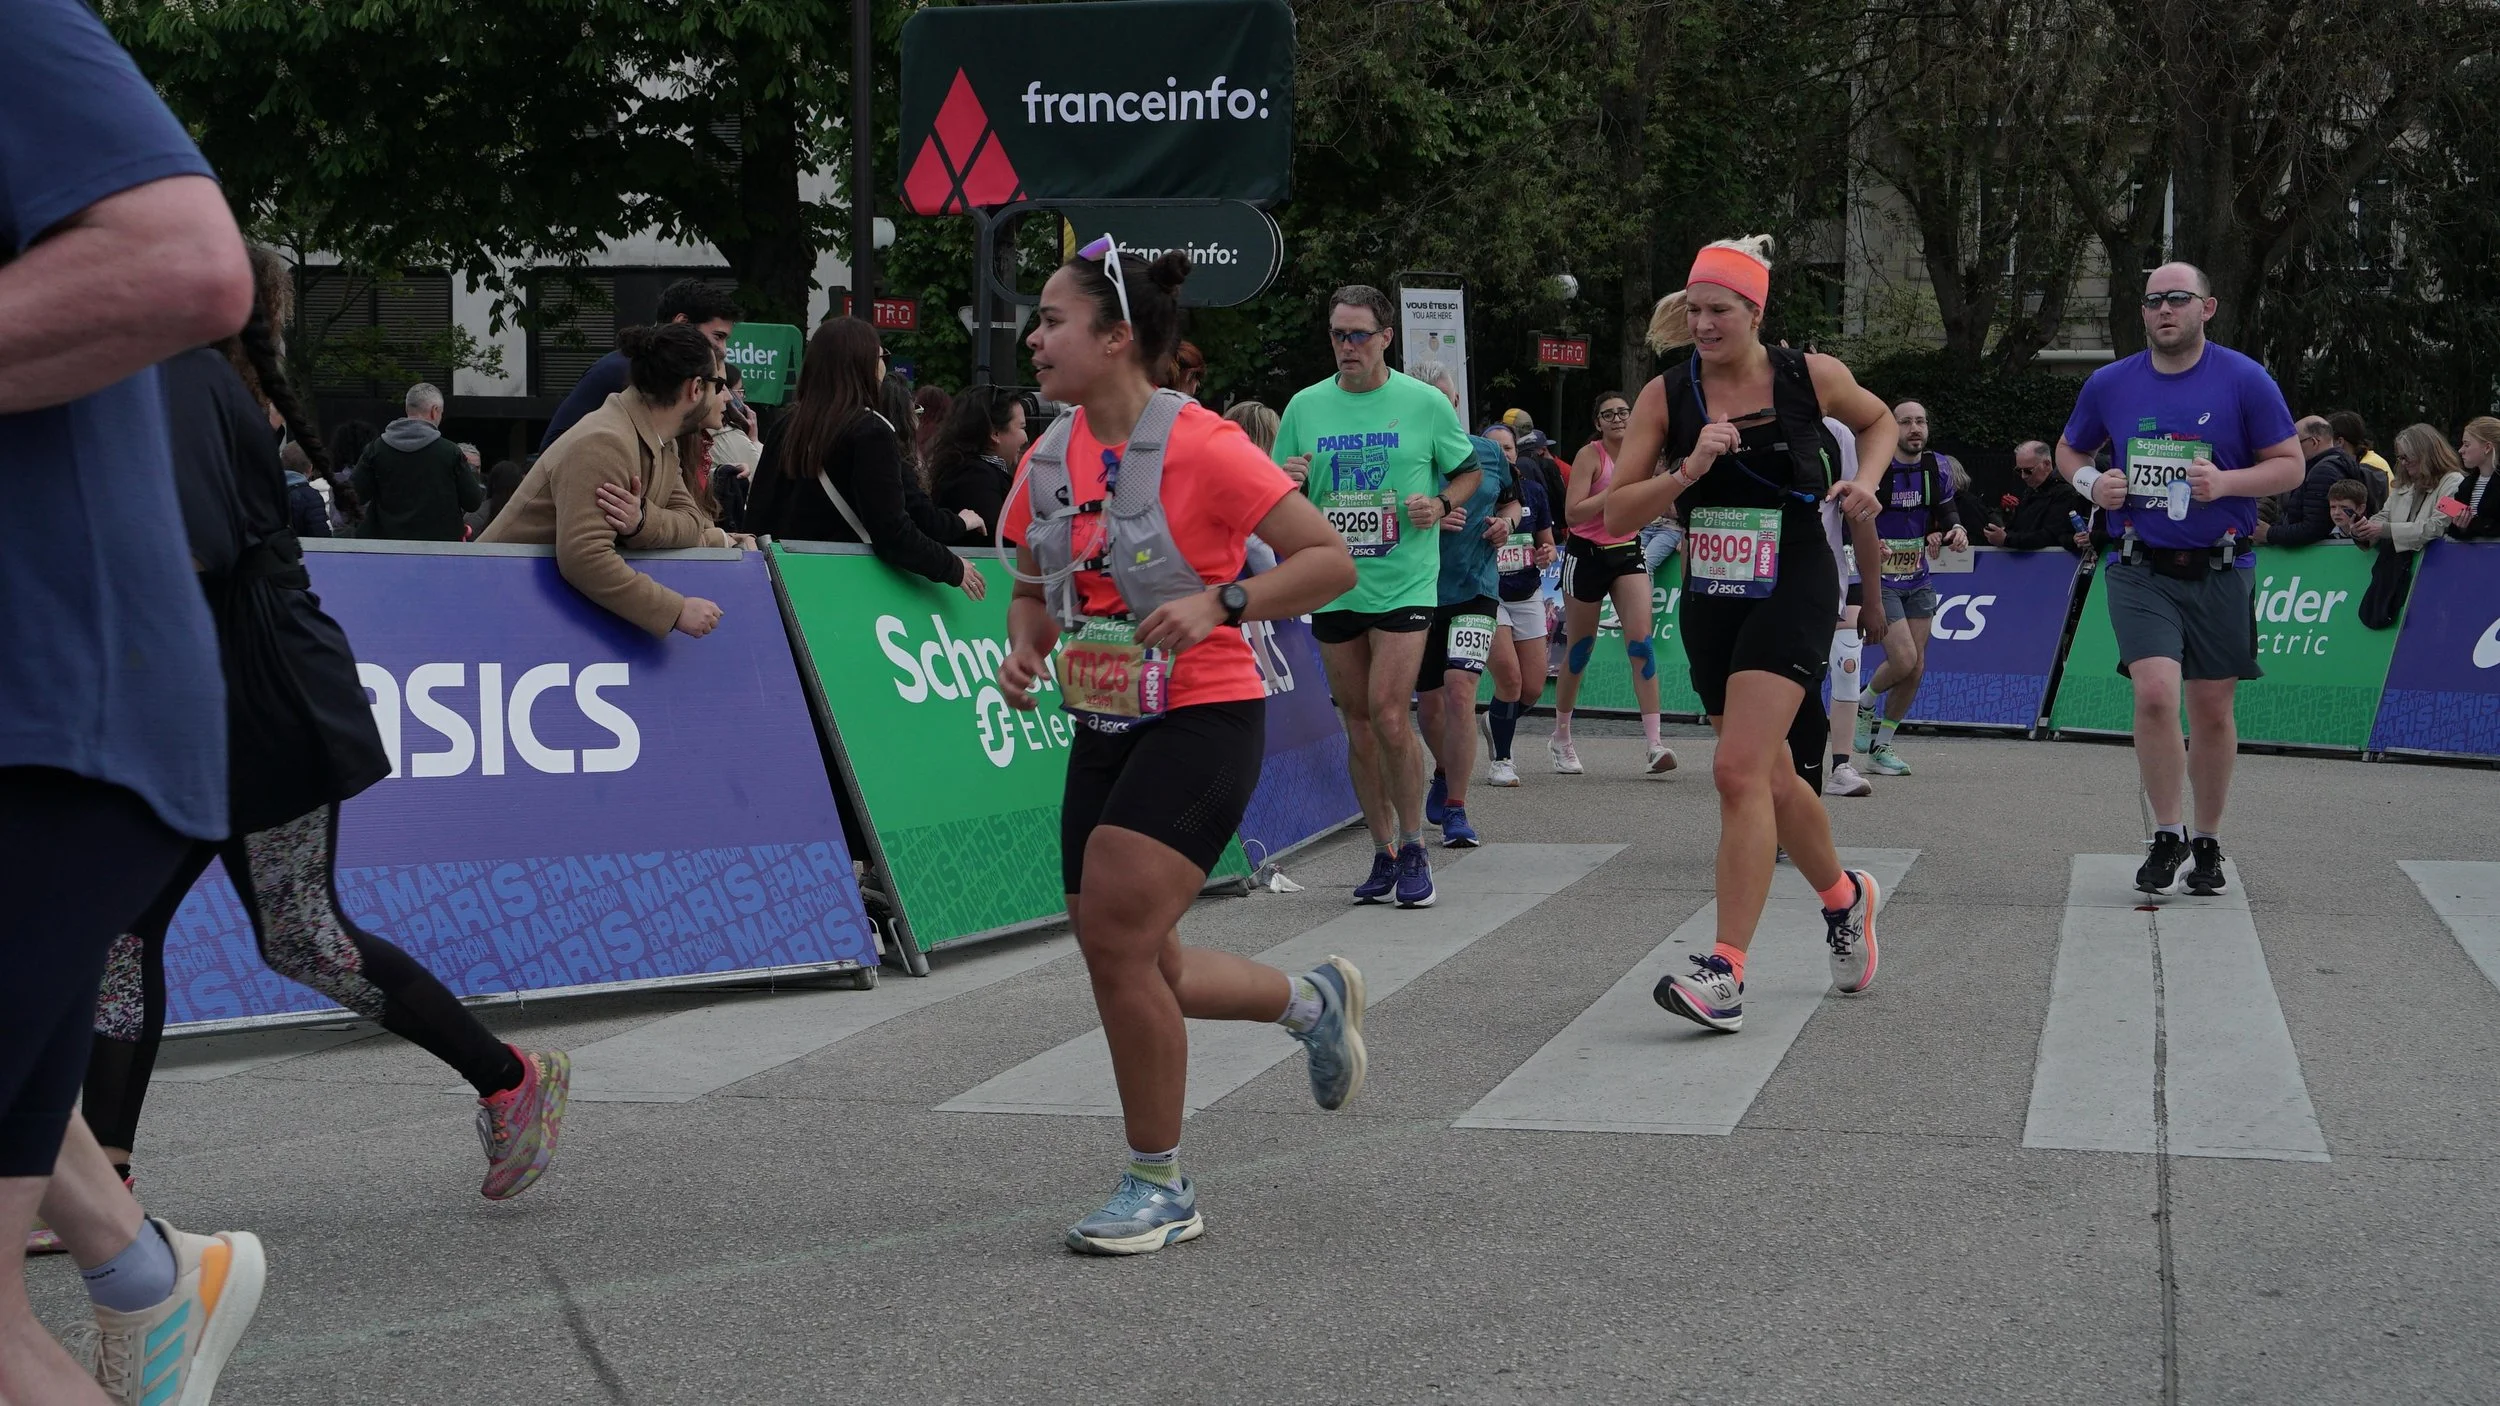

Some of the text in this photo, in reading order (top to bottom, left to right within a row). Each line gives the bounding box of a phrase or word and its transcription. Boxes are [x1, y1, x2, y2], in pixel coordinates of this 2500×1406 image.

[1021, 76, 1269, 123] franceinfo:
[1429, 301, 1447, 310] ÊTES
[1412, 311, 1425, 319] YOU
[724, 341, 778, 365] eider
[741, 368, 776, 380] ctric
[1317, 433, 1363, 453] PARIS
[1366, 432, 1399, 448] RUN
[2137, 440, 2186, 452] Schneider
[1330, 492, 1374, 501] Schneider
[1690, 509, 1750, 520] Schneider
[1714, 520, 1748, 528] Electric
[1690, 533, 1752, 564] 78909
[1718, 584, 1746, 594] asics
[1458, 616, 1492, 625] Schneider
[1088, 630, 1130, 642] Electric
[1456, 631, 1490, 651] 69315
[2257, 629, 2329, 655] ctric
[407, 862, 537, 947] PARIS
[651, 862, 767, 947] PARIS
